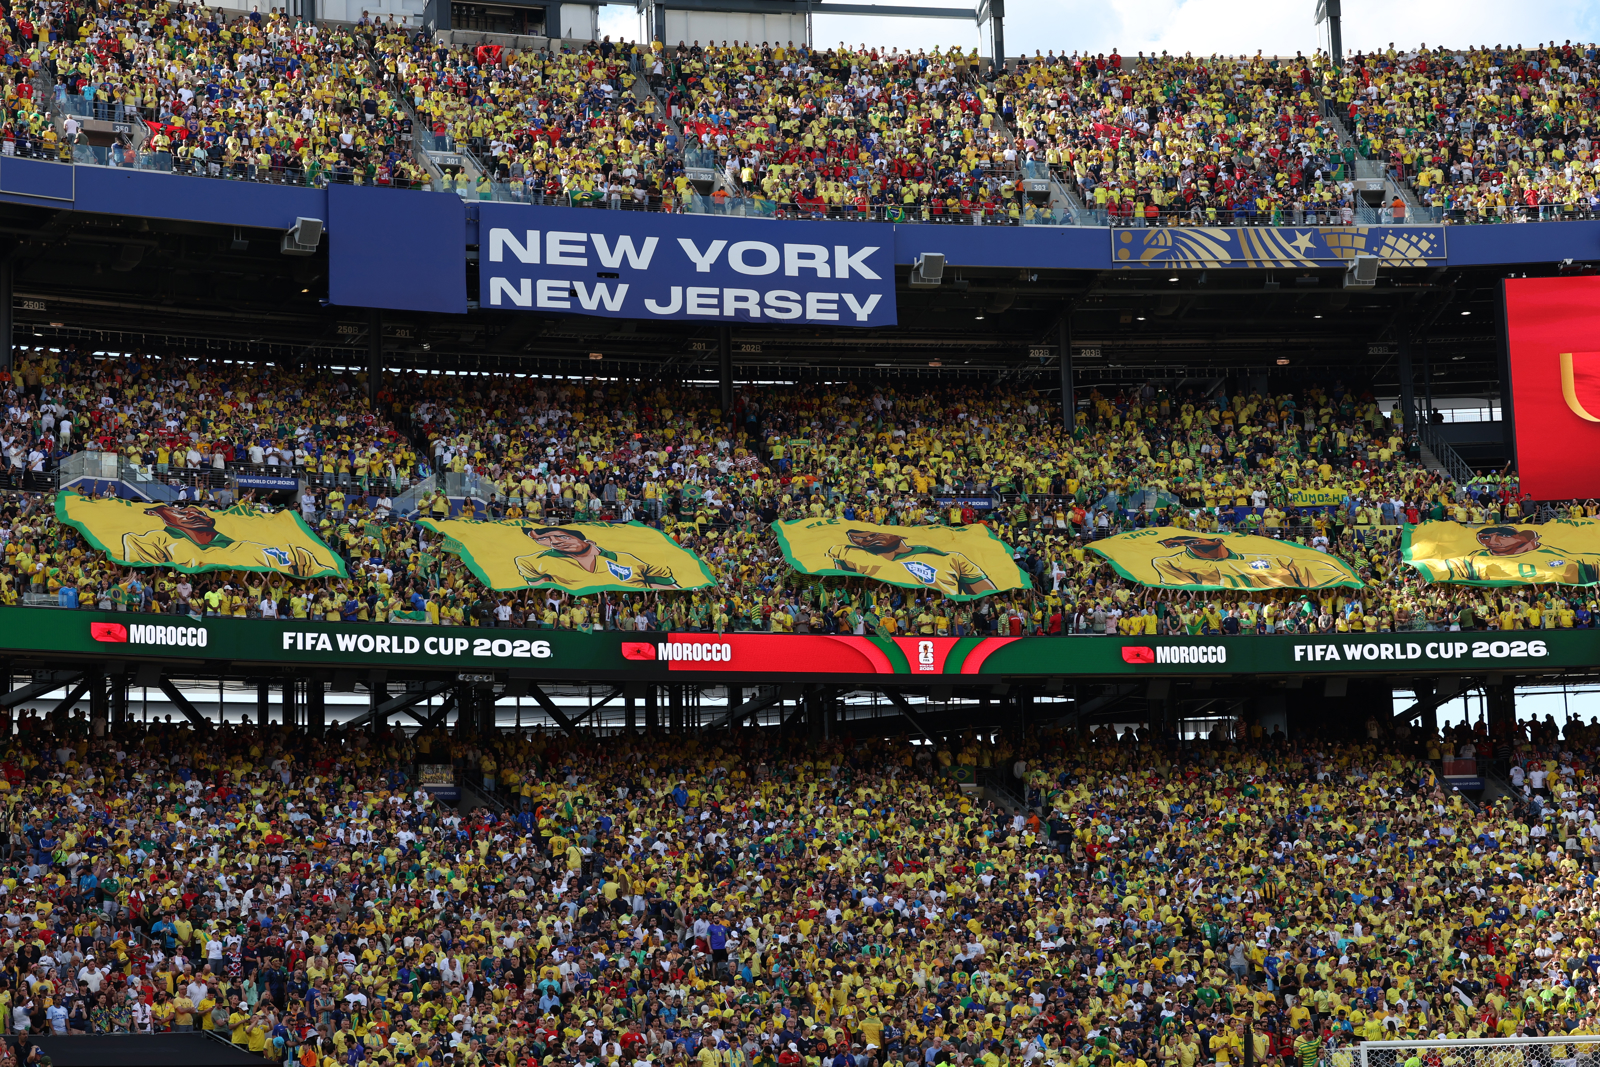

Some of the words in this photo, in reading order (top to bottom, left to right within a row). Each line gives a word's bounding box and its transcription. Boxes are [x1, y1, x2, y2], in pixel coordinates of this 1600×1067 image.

[489, 227, 659, 270] NEW
[676, 238, 883, 280] YORK
[23, 300, 46, 309] 250B
[489, 276, 630, 312] NEW
[643, 286, 883, 322] JERSEY
[337, 325, 359, 334] 250B
[395, 329, 410, 337] 201
[692, 342, 706, 350] 201
[1029, 349, 1050, 357] 202B
[1081, 349, 1101, 357] 203B
[1292, 493, 1325, 503] RUMO
[129, 623, 208, 647] MOROCCO
[282, 631, 333, 651] FIFA
[336, 633, 420, 654] WORLD
[423, 637, 469, 655] CUP
[472, 639, 551, 658] 2026
[1294, 645, 1341, 662] FIFA
[1342, 643, 1422, 661] WORLD
[1425, 642, 1468, 659] CUP
[1471, 640, 1547, 658] 2026
[657, 642, 732, 662] MOROCCO
[1156, 645, 1227, 664] MOROCCO
